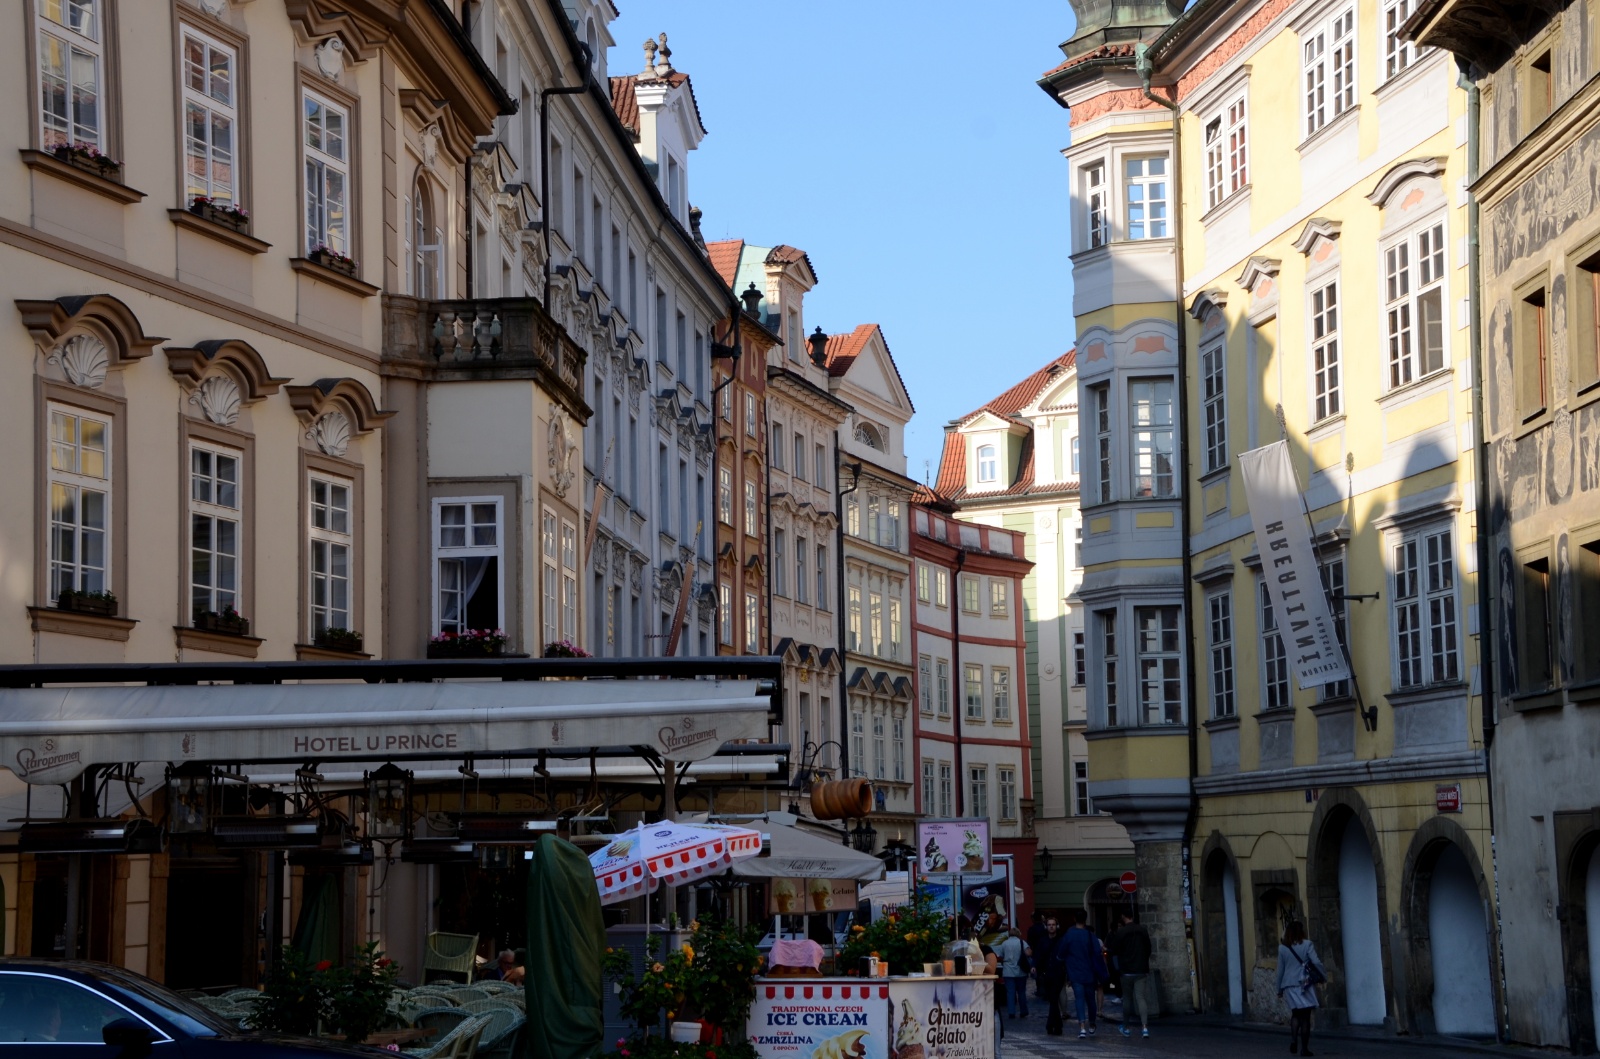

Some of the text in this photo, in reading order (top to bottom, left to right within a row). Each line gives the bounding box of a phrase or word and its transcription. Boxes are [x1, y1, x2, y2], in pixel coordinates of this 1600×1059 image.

[294, 733, 457, 752] HOTEL U PRINCE
[658, 726, 718, 754] Staropramen
[16, 748, 82, 777] Staropramen
[832, 888, 855, 896] Gelato
[767, 1013, 868, 1026] ICE CREAM
[928, 1006, 984, 1028] Chimney
[758, 1036, 814, 1045] ZMRZLINA
[927, 1028, 967, 1048] Gelato
